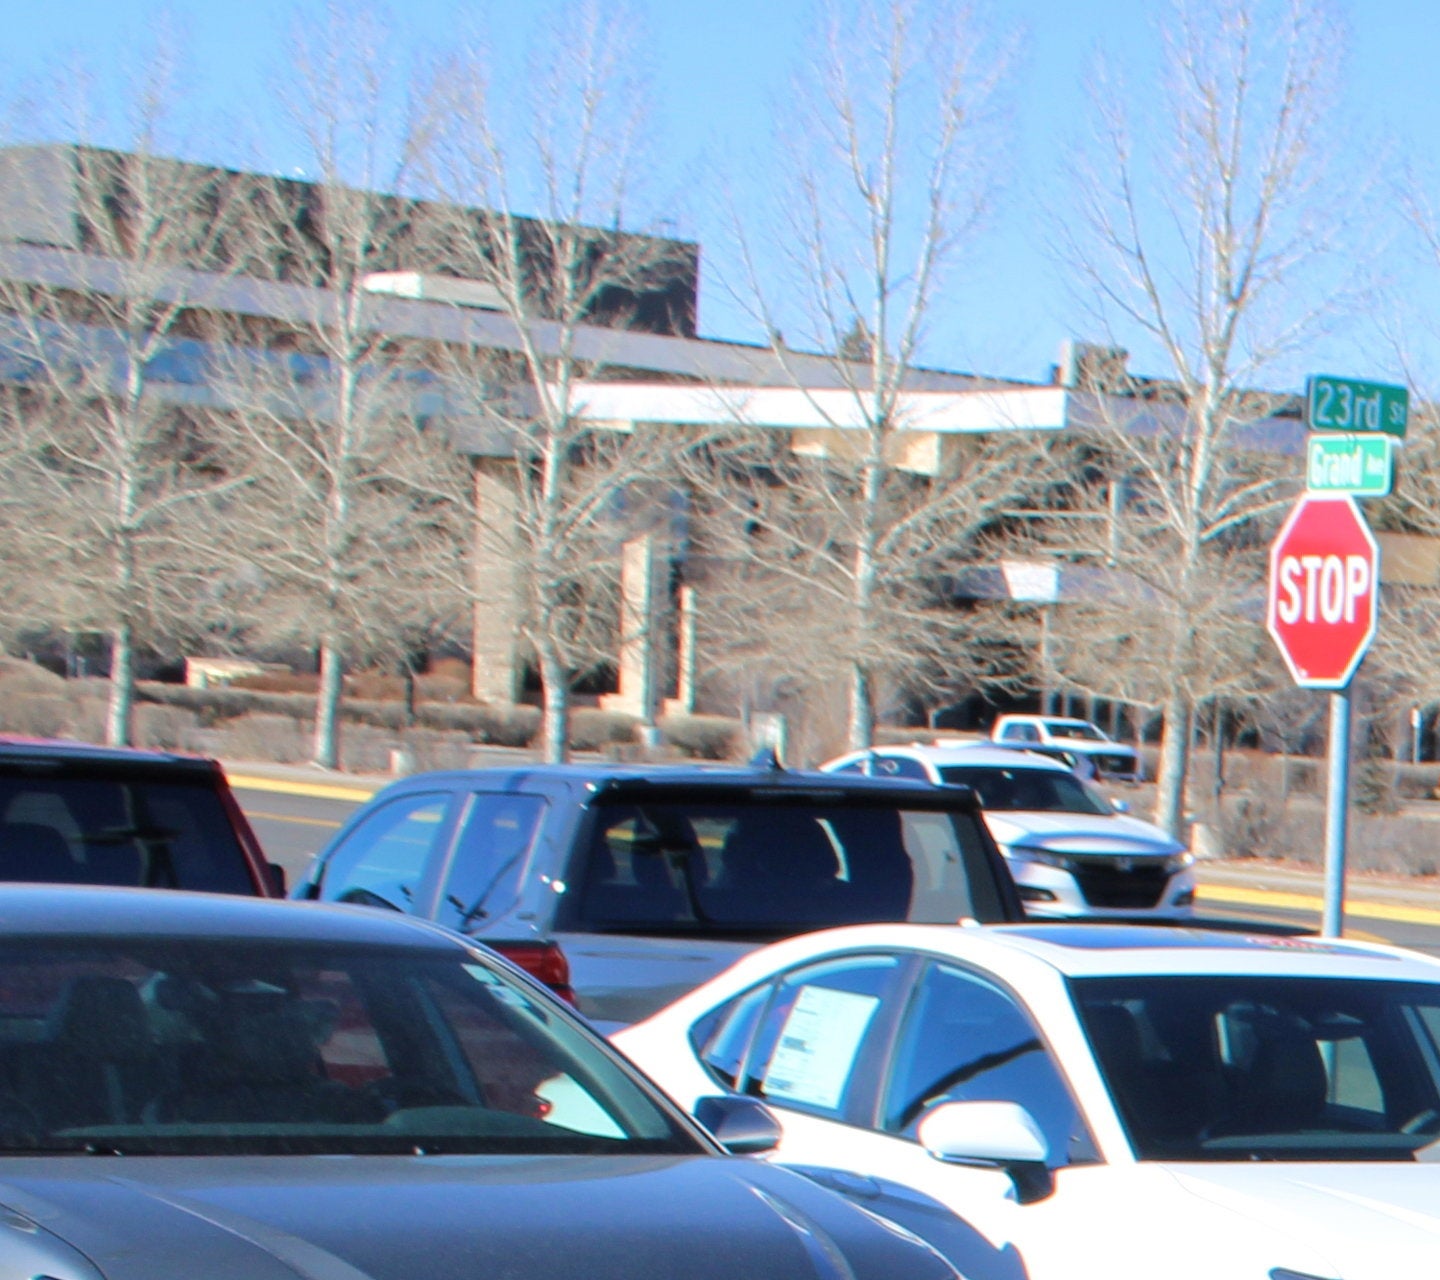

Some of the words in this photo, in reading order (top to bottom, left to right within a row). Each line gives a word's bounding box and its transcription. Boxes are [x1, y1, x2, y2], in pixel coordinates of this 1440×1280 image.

[1317, 381, 1381, 430] 23rd
[1311, 443, 1363, 487] Grand
[1277, 555, 1370, 625] STOP
